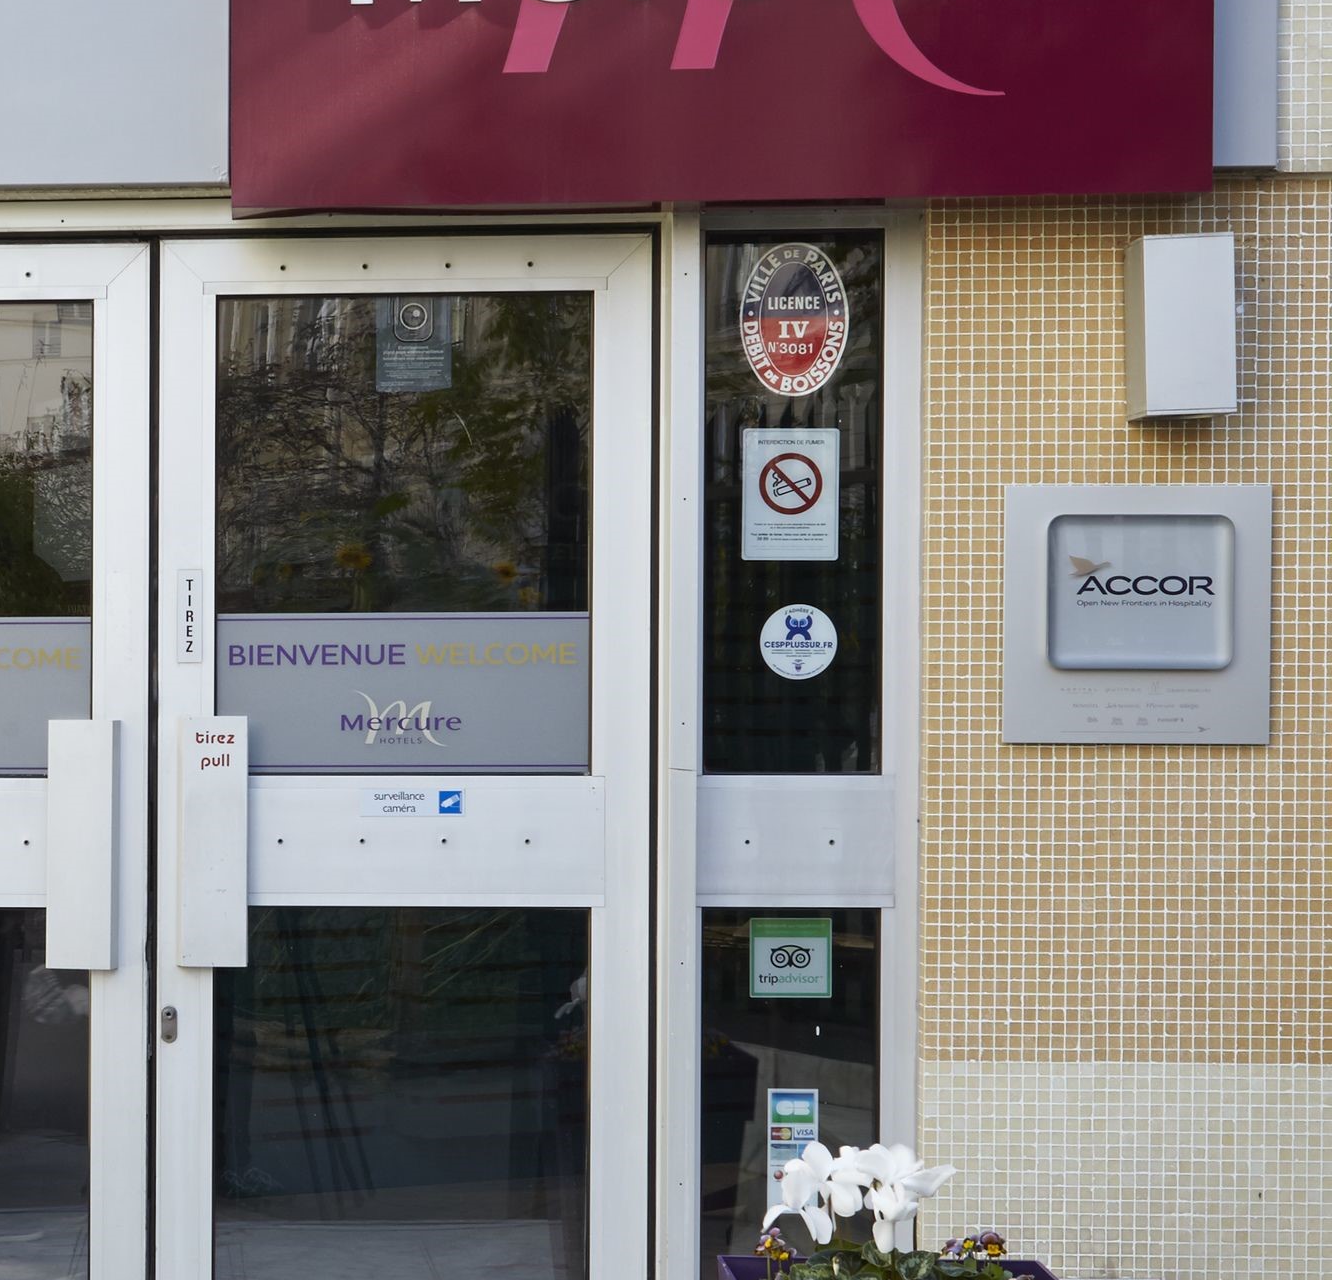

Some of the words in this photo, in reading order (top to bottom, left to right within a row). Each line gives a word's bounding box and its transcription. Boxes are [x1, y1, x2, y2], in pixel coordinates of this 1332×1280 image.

[745, 254, 782, 304] VILLE
[783, 249, 800, 260] DE
[803, 250, 842, 304] PARIS
[768, 296, 820, 310] LICENCE
[778, 320, 810, 339] IV
[743, 320, 770, 371] DEBIT
[763, 368, 780, 385] DE
[779, 320, 845, 392] BOISSONS
[1076, 575, 1215, 596] ACCOR
[1076, 599, 1098, 608] Open
[1100, 599, 1119, 607] New
[1121, 599, 1157, 607] Frontiers
[1159, 599, 1167, 607] in
[1168, 599, 1213, 608] Hospitality
[185, 579, 194, 653] TIREZ
[764, 641, 833, 649] CESPPLUSSUR.FR
[228, 643, 406, 667] BIENVENUE
[415, 641, 579, 666] WELCOME
[340, 714, 463, 732] Mercure
[195, 731, 235, 744] tirez
[379, 736, 424, 745] HOTELS
[201, 754, 230, 770] pull
[374, 791, 425, 801] surveillance
[382, 803, 416, 813] caméra
[759, 973, 819, 986] tripadvisor
[776, 1100, 810, 1116] CB
[796, 1128, 814, 1136] VISA
